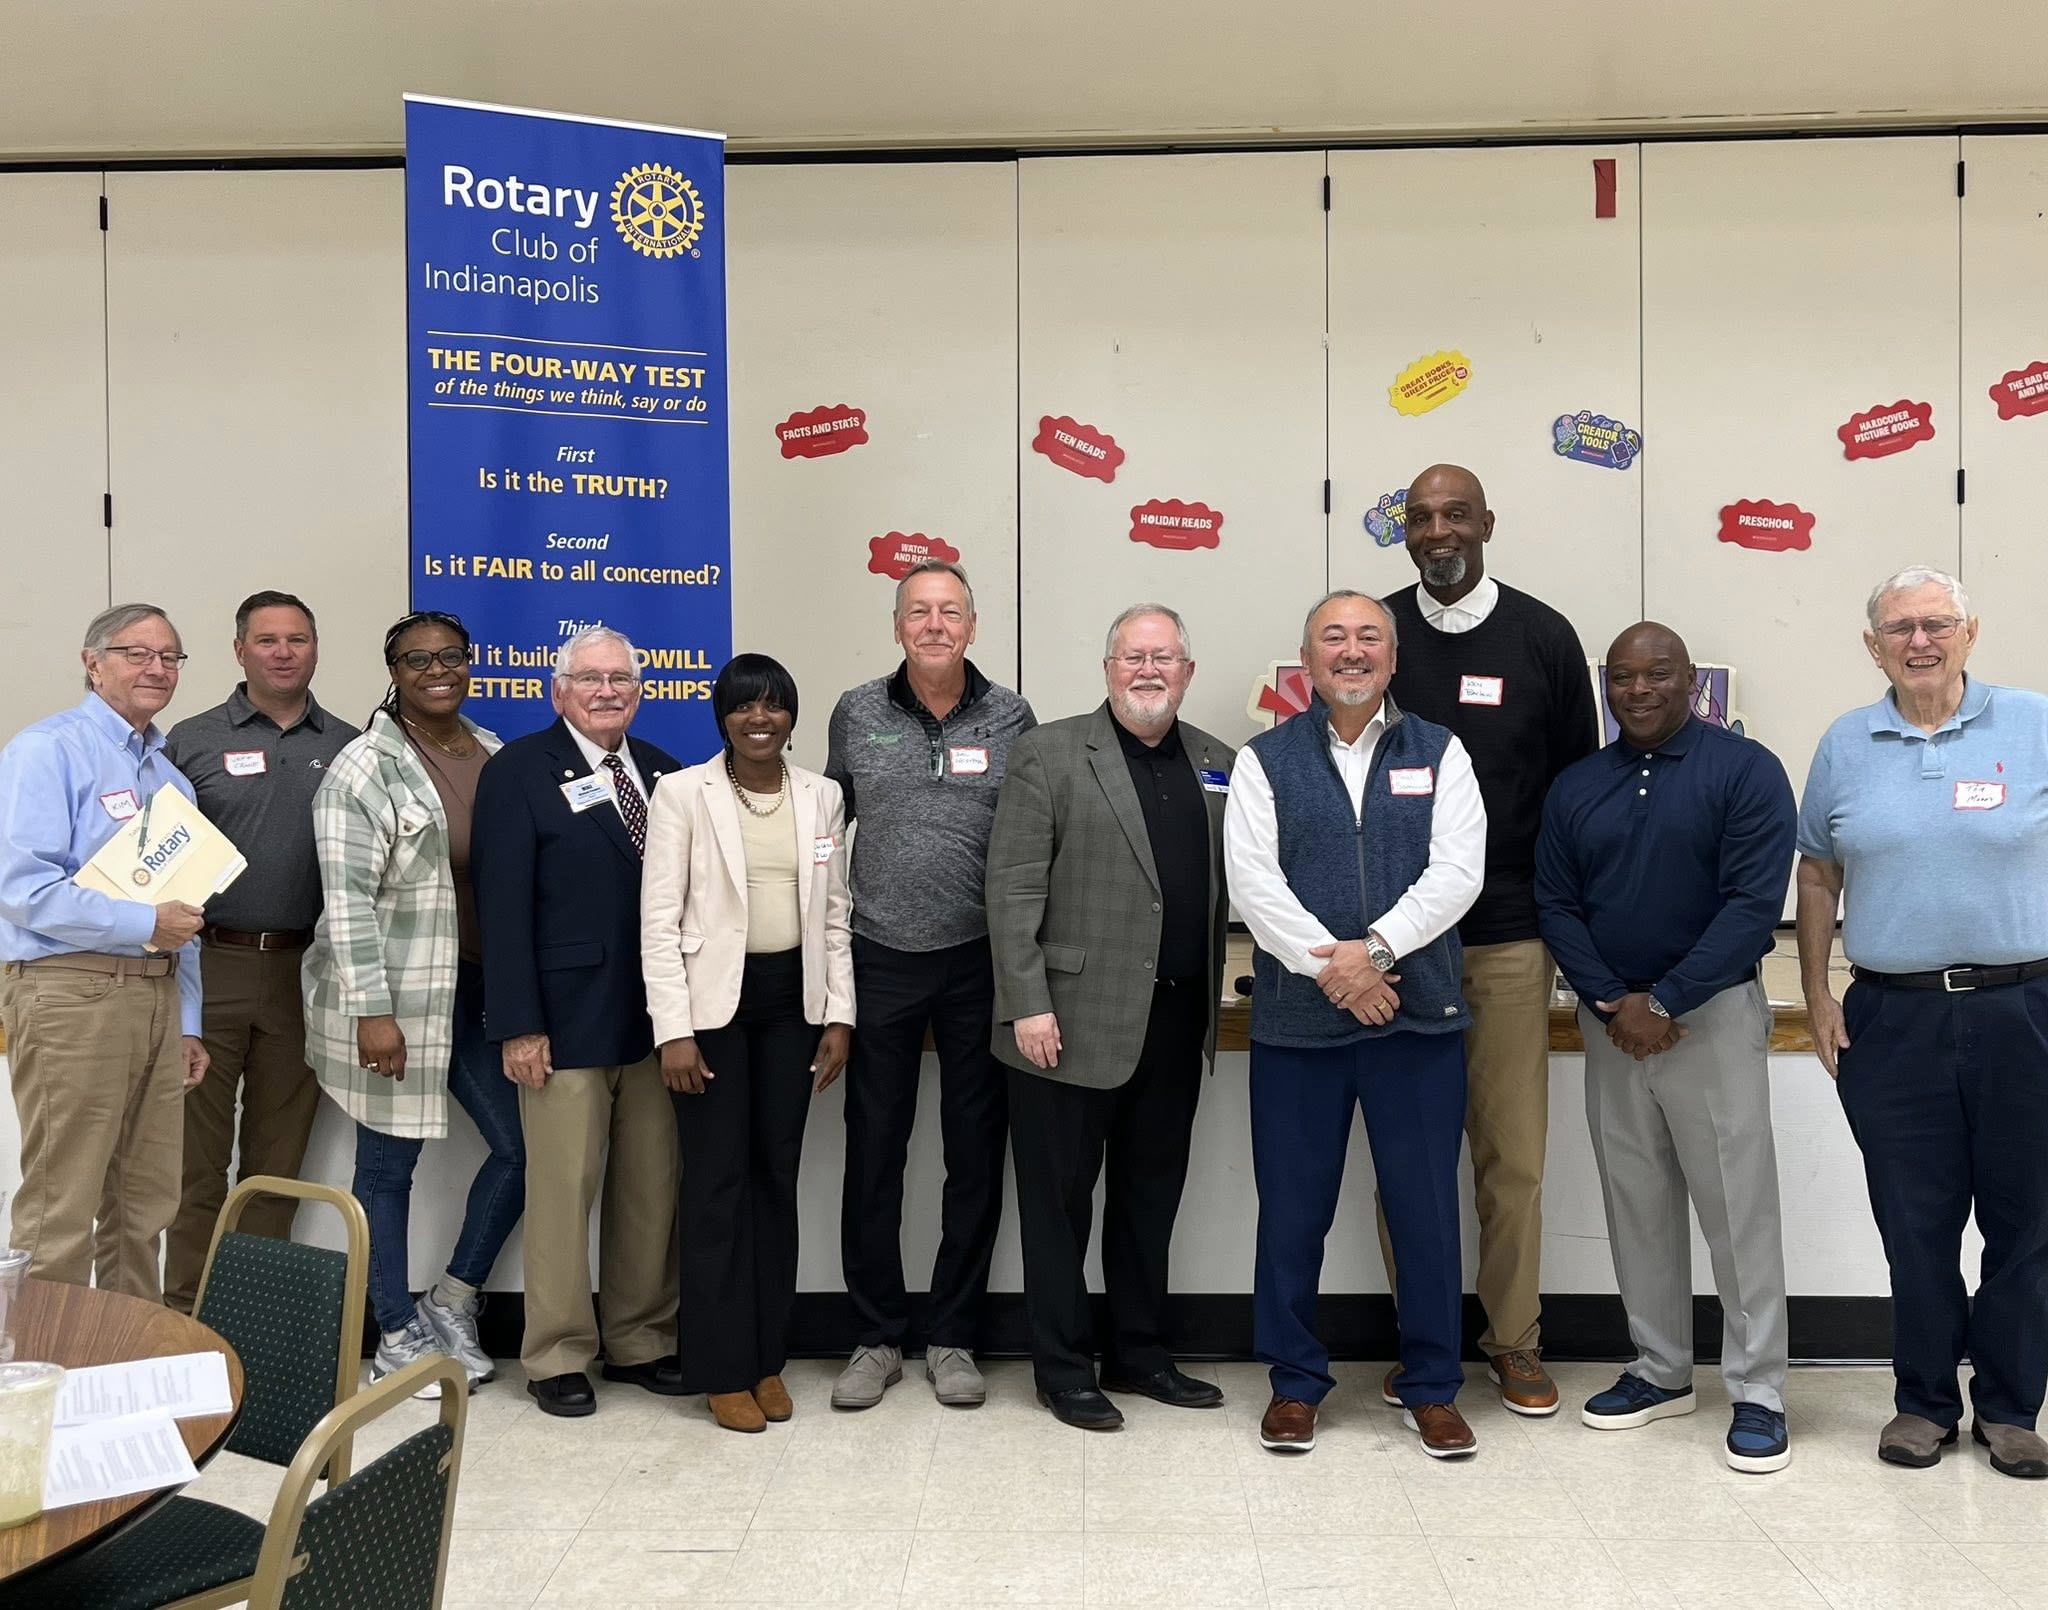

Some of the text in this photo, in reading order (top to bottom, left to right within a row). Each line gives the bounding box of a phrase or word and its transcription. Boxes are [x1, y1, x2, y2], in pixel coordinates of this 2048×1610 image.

[638, 173, 676, 187] ROTARY
[443, 164, 599, 229] Rotary
[491, 228, 599, 263] Club of
[625, 221, 691, 249] INTERNATIONAL
[425, 262, 599, 305] Indianapolis
[428, 348, 706, 389] THE FOUR-WAY TEST
[1400, 375, 1425, 392] GREAT
[1404, 381, 1429, 399] GREAT
[1428, 366, 1456, 385] PRICES
[2007, 379, 2025, 392] THE
[2023, 373, 2043, 387] BAD
[2018, 386, 2036, 400] AND
[434, 378, 707, 413] of the things we think, say or do
[783, 416, 860, 441] FACTS AND STATS
[1854, 425, 1890, 444] PICTURE
[1890, 417, 1920, 434] BOOKS
[1859, 410, 1910, 432] HARDCOVER
[1577, 423, 1619, 442] CREATOR
[1582, 434, 1610, 450] TOOLS
[557, 446, 595, 464] First
[1054, 429, 1078, 448] TEEN
[1076, 439, 1107, 461] READS
[479, 468, 668, 499] Is it the TRUTH?
[1140, 513, 1213, 530] HOLIDAY READS
[1739, 514, 1795, 530] PRESCHOOL
[546, 533, 609, 551] Second
[901, 543, 929, 555] WATCH
[893, 552, 911, 563] AND
[425, 555, 720, 585] Is it FAIR to all concerned?
[487, 644, 502, 666] it
[468, 677, 544, 699] ETTER
[143, 825, 191, 871] Rotary
